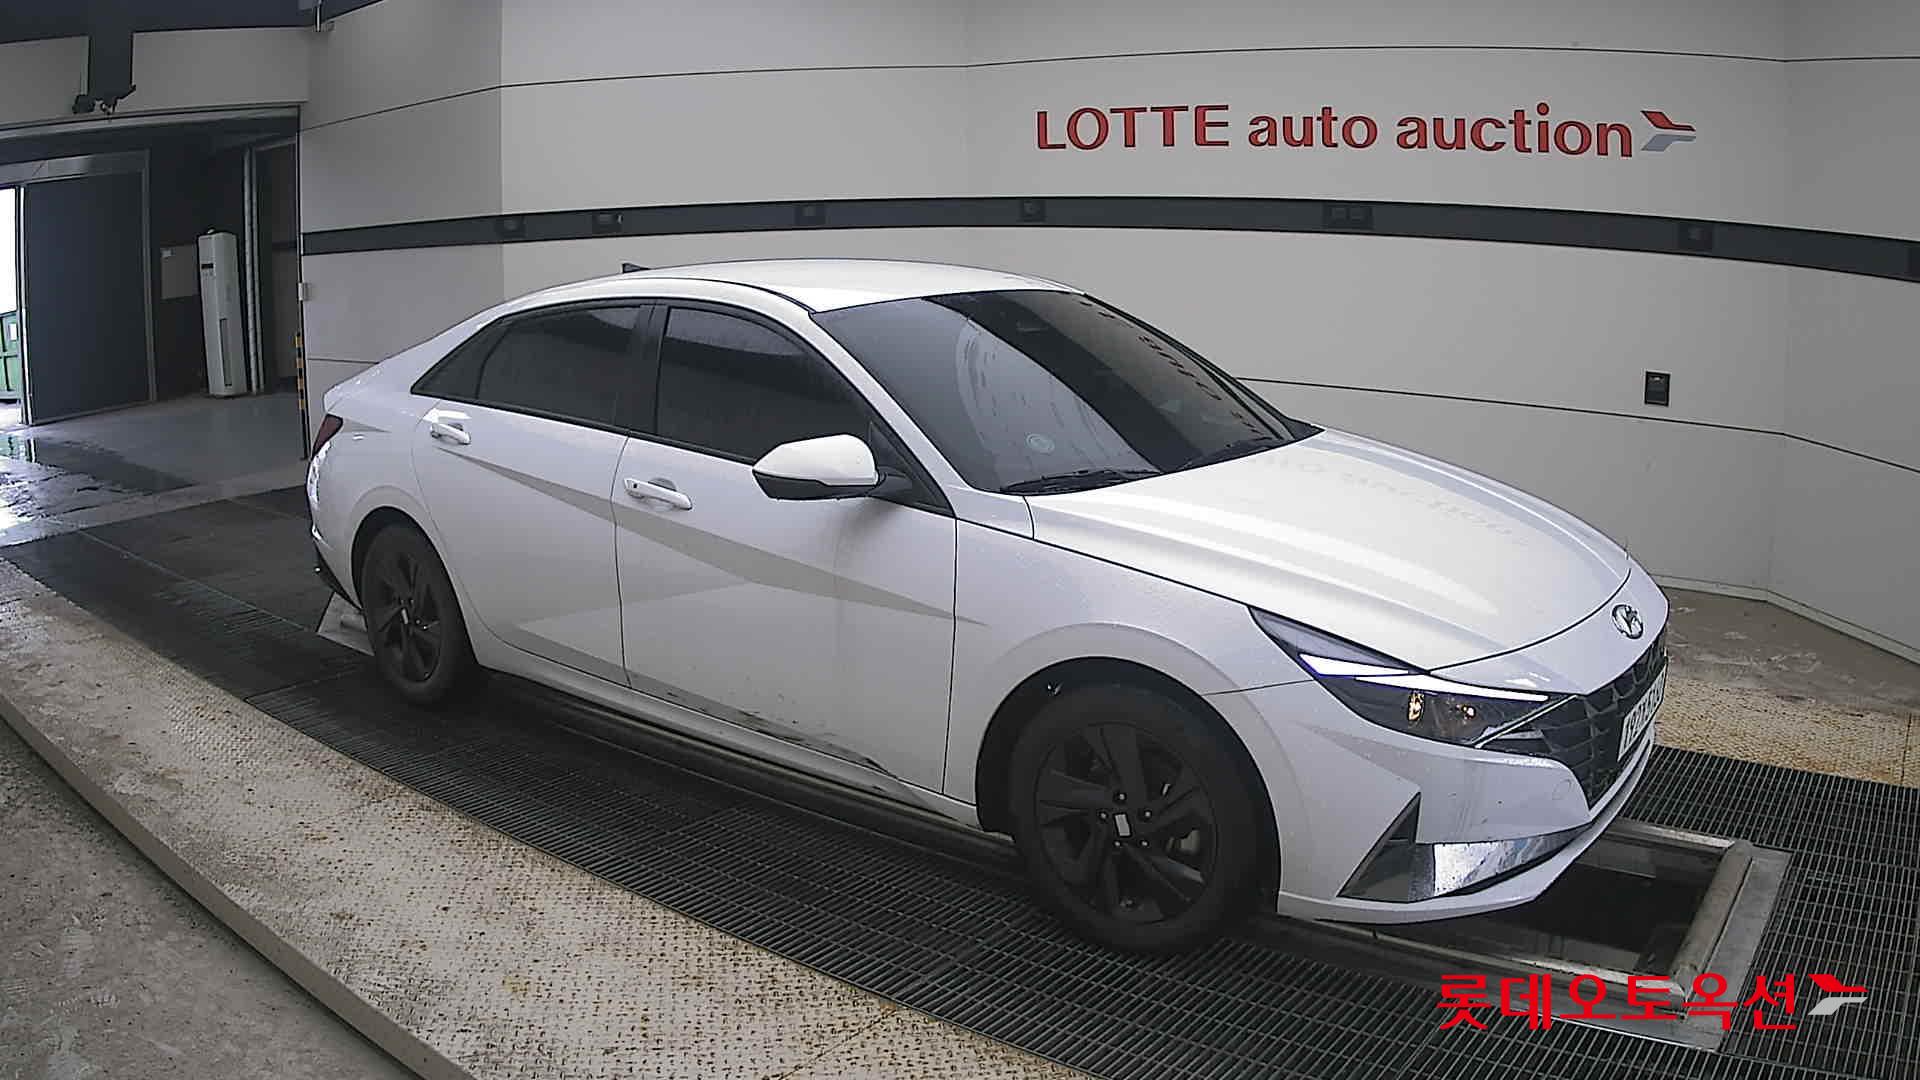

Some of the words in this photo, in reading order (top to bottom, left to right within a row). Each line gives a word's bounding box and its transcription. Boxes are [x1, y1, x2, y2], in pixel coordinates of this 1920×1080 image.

[1037, 104, 1230, 151] LOTTE
[1248, 106, 1378, 149] auto
[1396, 102, 1633, 158] auction
